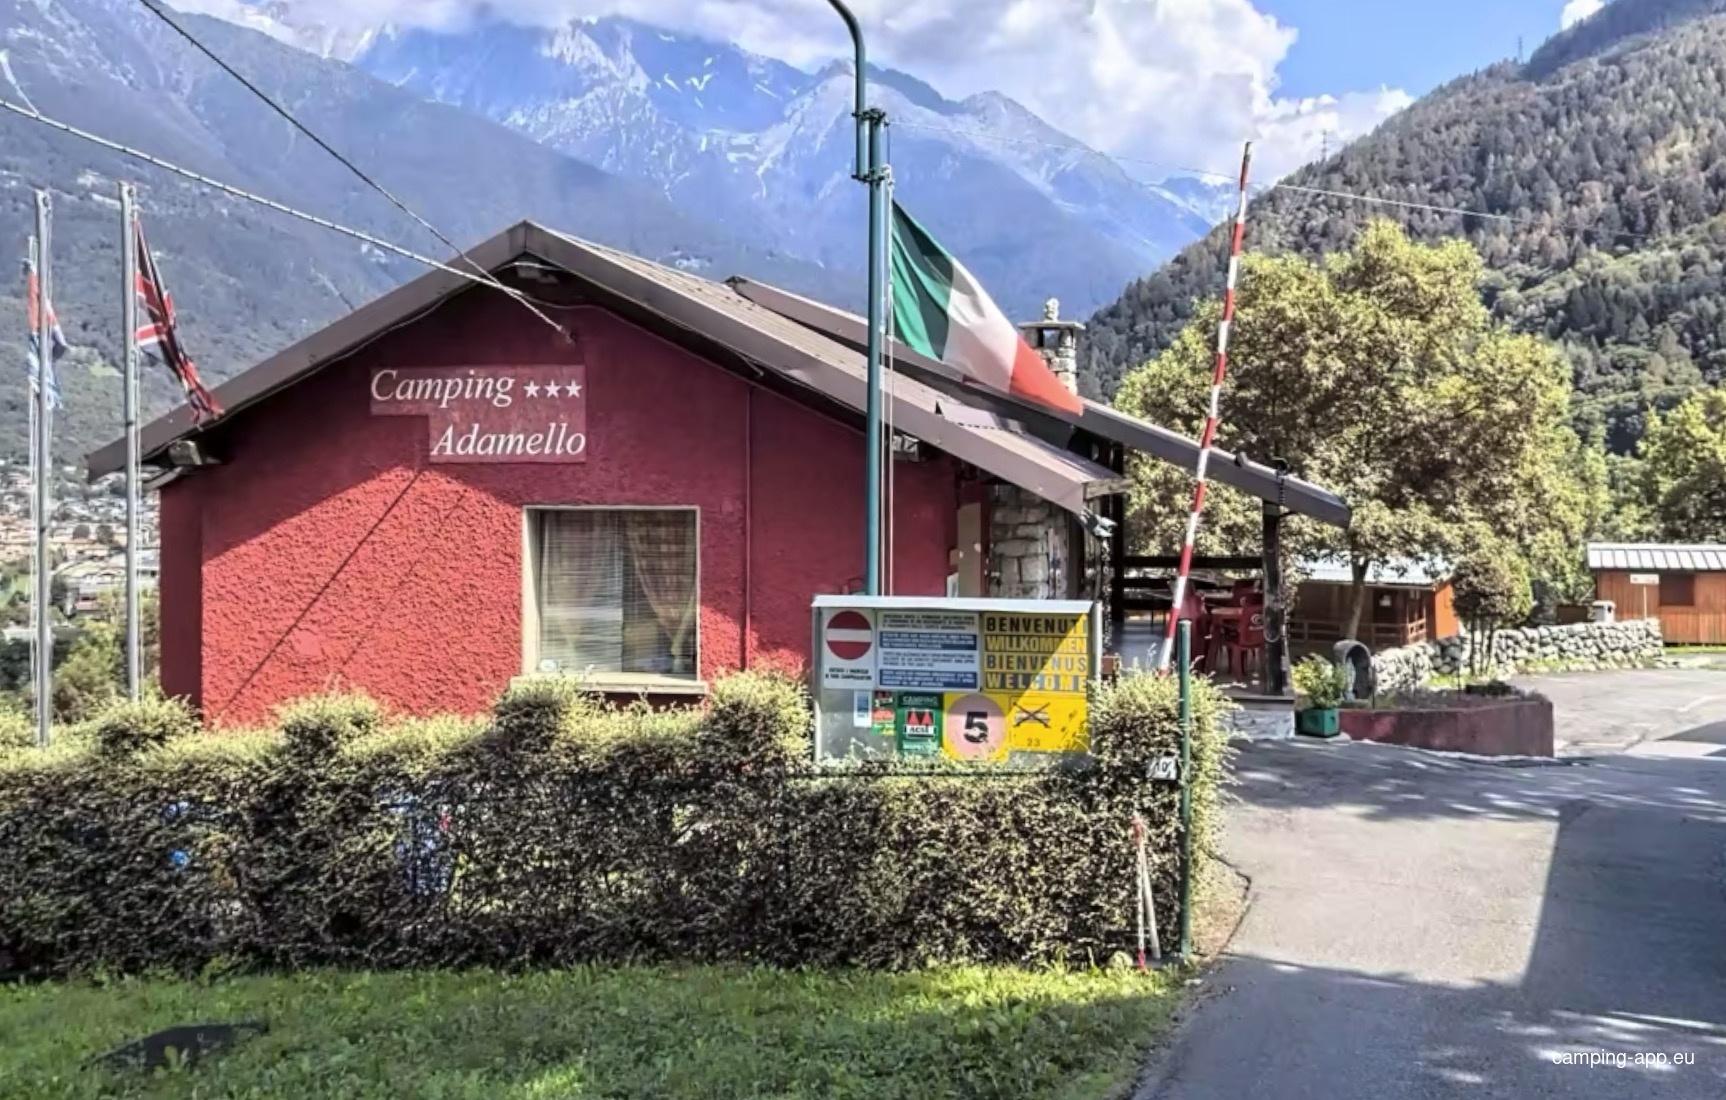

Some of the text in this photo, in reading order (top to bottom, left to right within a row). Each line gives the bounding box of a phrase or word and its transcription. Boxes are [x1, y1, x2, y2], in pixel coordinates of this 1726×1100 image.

[371, 369, 516, 408] Camping
[430, 422, 586, 456] Adamello
[986, 654, 1087, 672] BIENVENUS
[963, 711, 989, 744] 5
